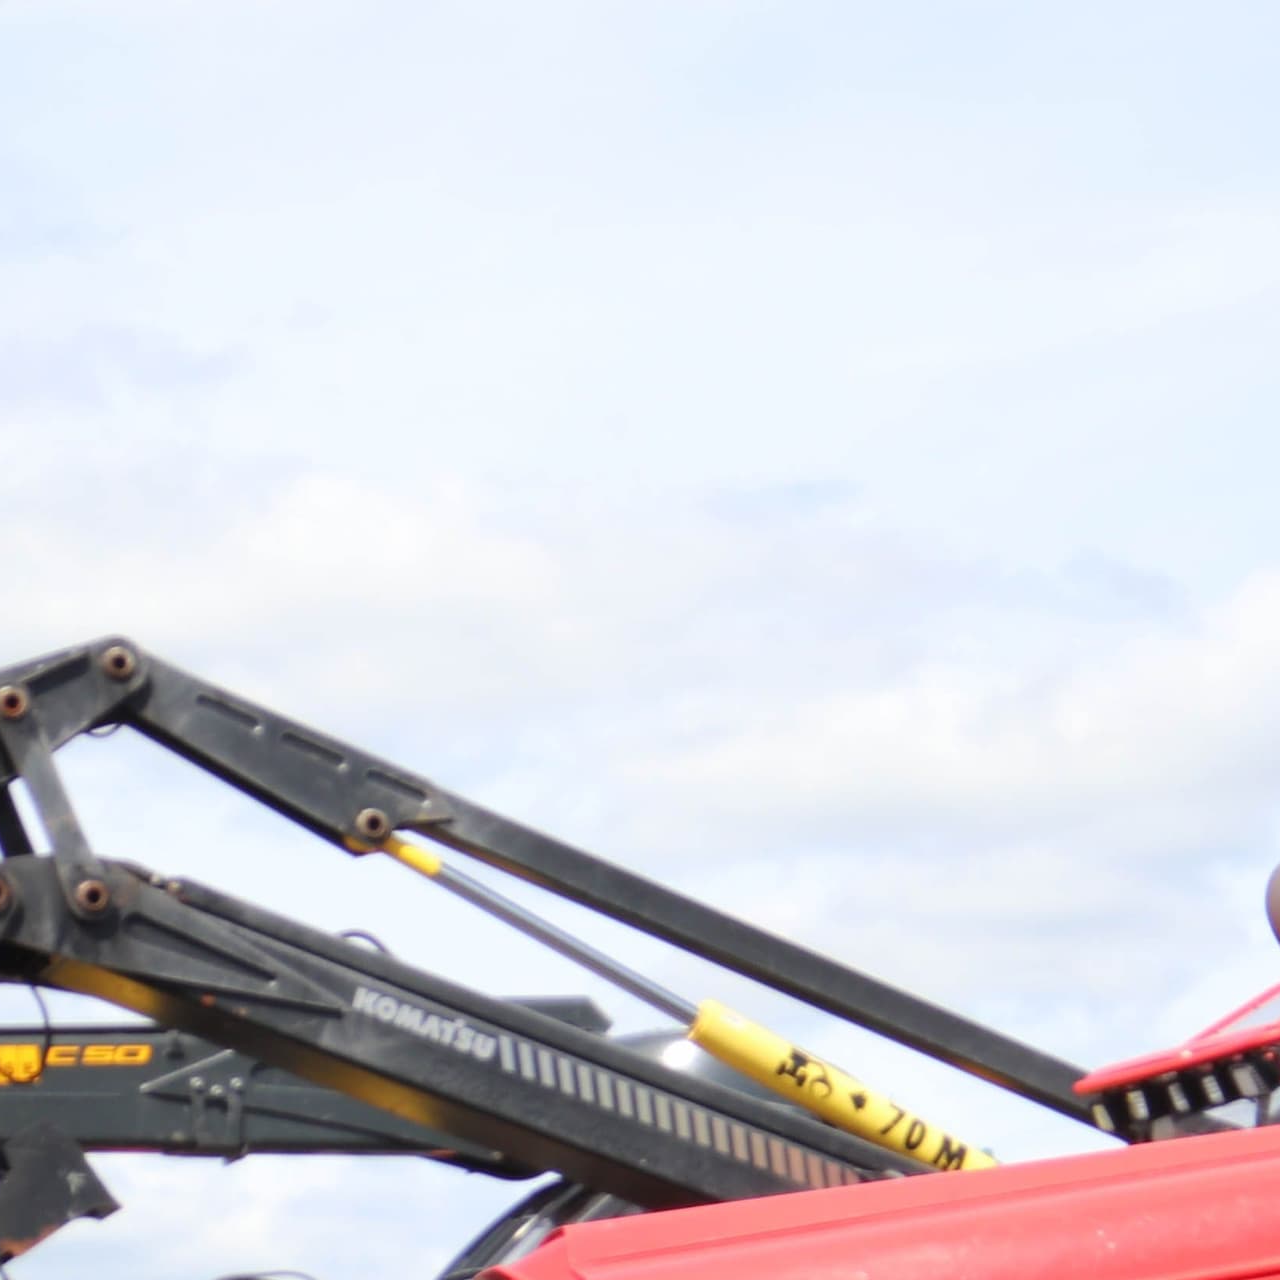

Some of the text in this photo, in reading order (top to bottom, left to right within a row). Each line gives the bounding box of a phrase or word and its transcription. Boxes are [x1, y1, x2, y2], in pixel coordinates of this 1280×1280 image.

[352, 986, 497, 1061] KOMATSU
[880, 1102, 969, 1171] 70 M
